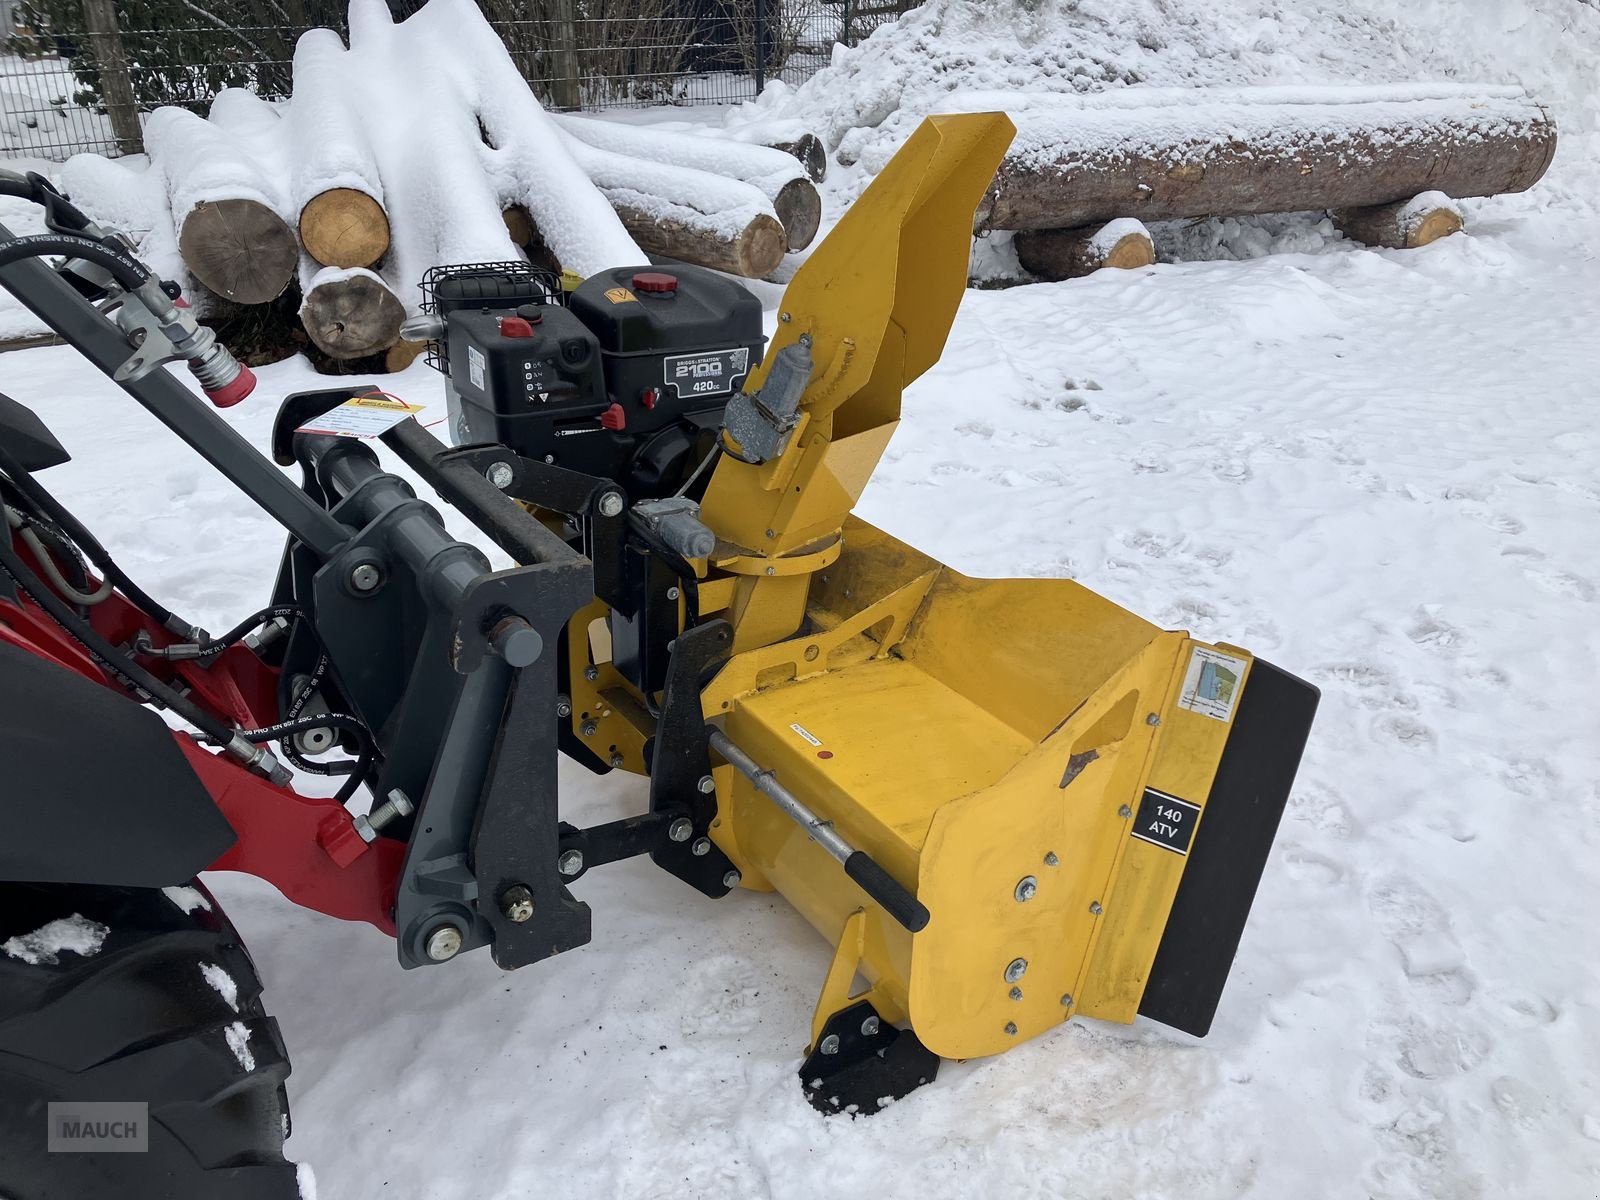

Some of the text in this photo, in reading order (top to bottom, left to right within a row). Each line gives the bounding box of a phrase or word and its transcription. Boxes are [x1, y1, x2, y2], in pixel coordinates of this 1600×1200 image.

[28, 235, 61, 243] MSHA
[78, 239, 94, 248] DN
[96, 243, 116, 257] 2SC
[132, 264, 145, 279] EN
[676, 361, 722, 378] 2100
[289, 708, 297, 718] EN
[253, 727, 268, 735] PRO
[272, 723, 283, 731] EN
[1156, 805, 1182, 823] 140
[1148, 820, 1178, 838] ATV
